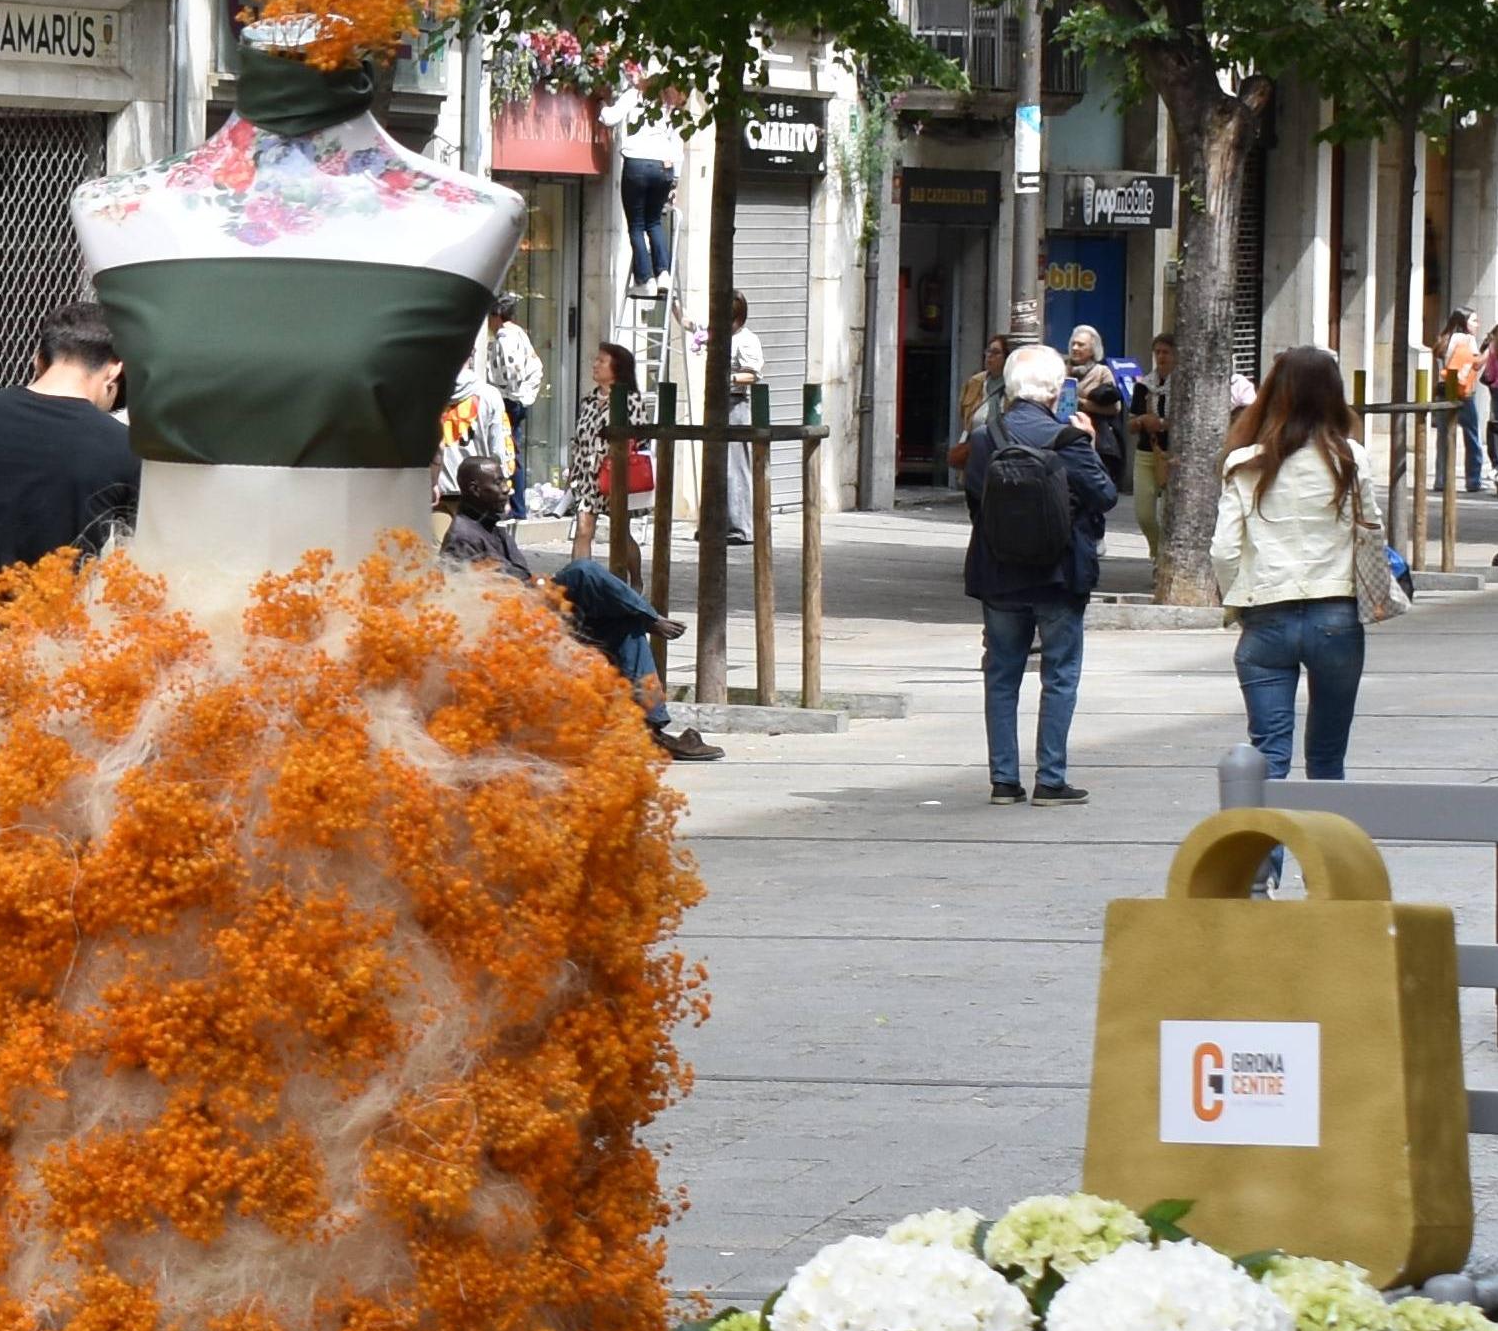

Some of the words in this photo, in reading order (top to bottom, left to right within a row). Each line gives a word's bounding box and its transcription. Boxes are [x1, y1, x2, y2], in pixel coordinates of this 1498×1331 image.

[1094, 180, 1155, 225] popmobile
[1232, 1052, 1284, 1073] GIRONA
[1232, 1075, 1284, 1095] CENTRE
